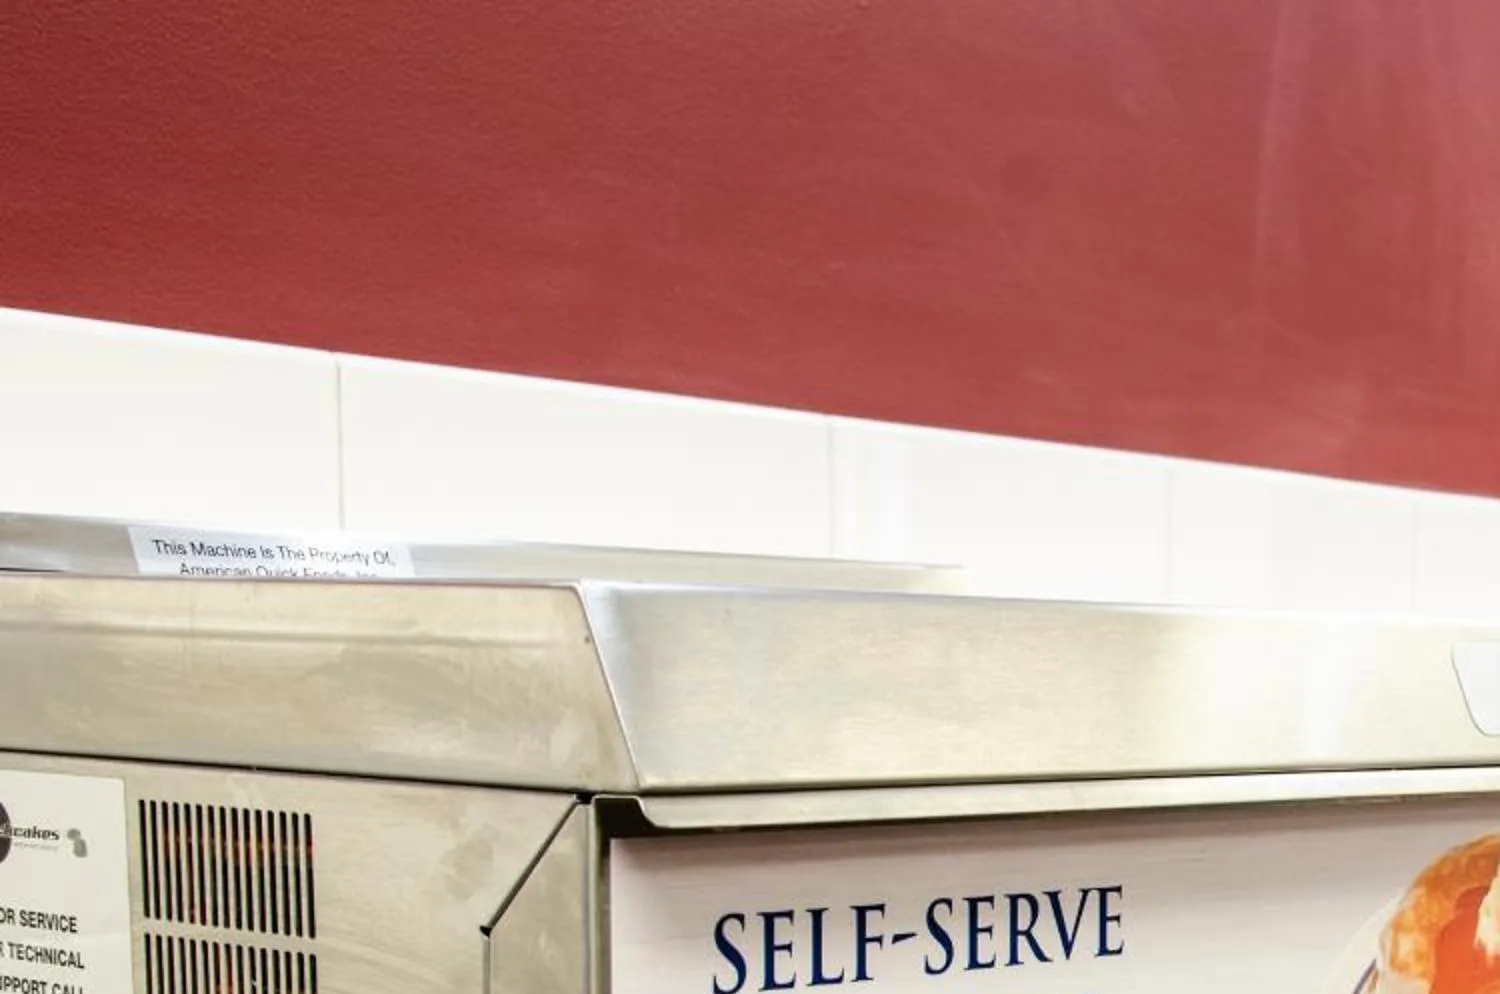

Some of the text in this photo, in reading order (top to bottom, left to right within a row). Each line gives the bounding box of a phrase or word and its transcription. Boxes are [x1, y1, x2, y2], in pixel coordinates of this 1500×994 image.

[152, 539, 186, 555] This
[190, 541, 257, 559] Machine
[260, 545, 275, 559] Is
[276, 546, 305, 561] The
[309, 548, 370, 567] Property
[19, 908, 78, 934] SERVICE
[7, 941, 86, 970] TECHNICAL
